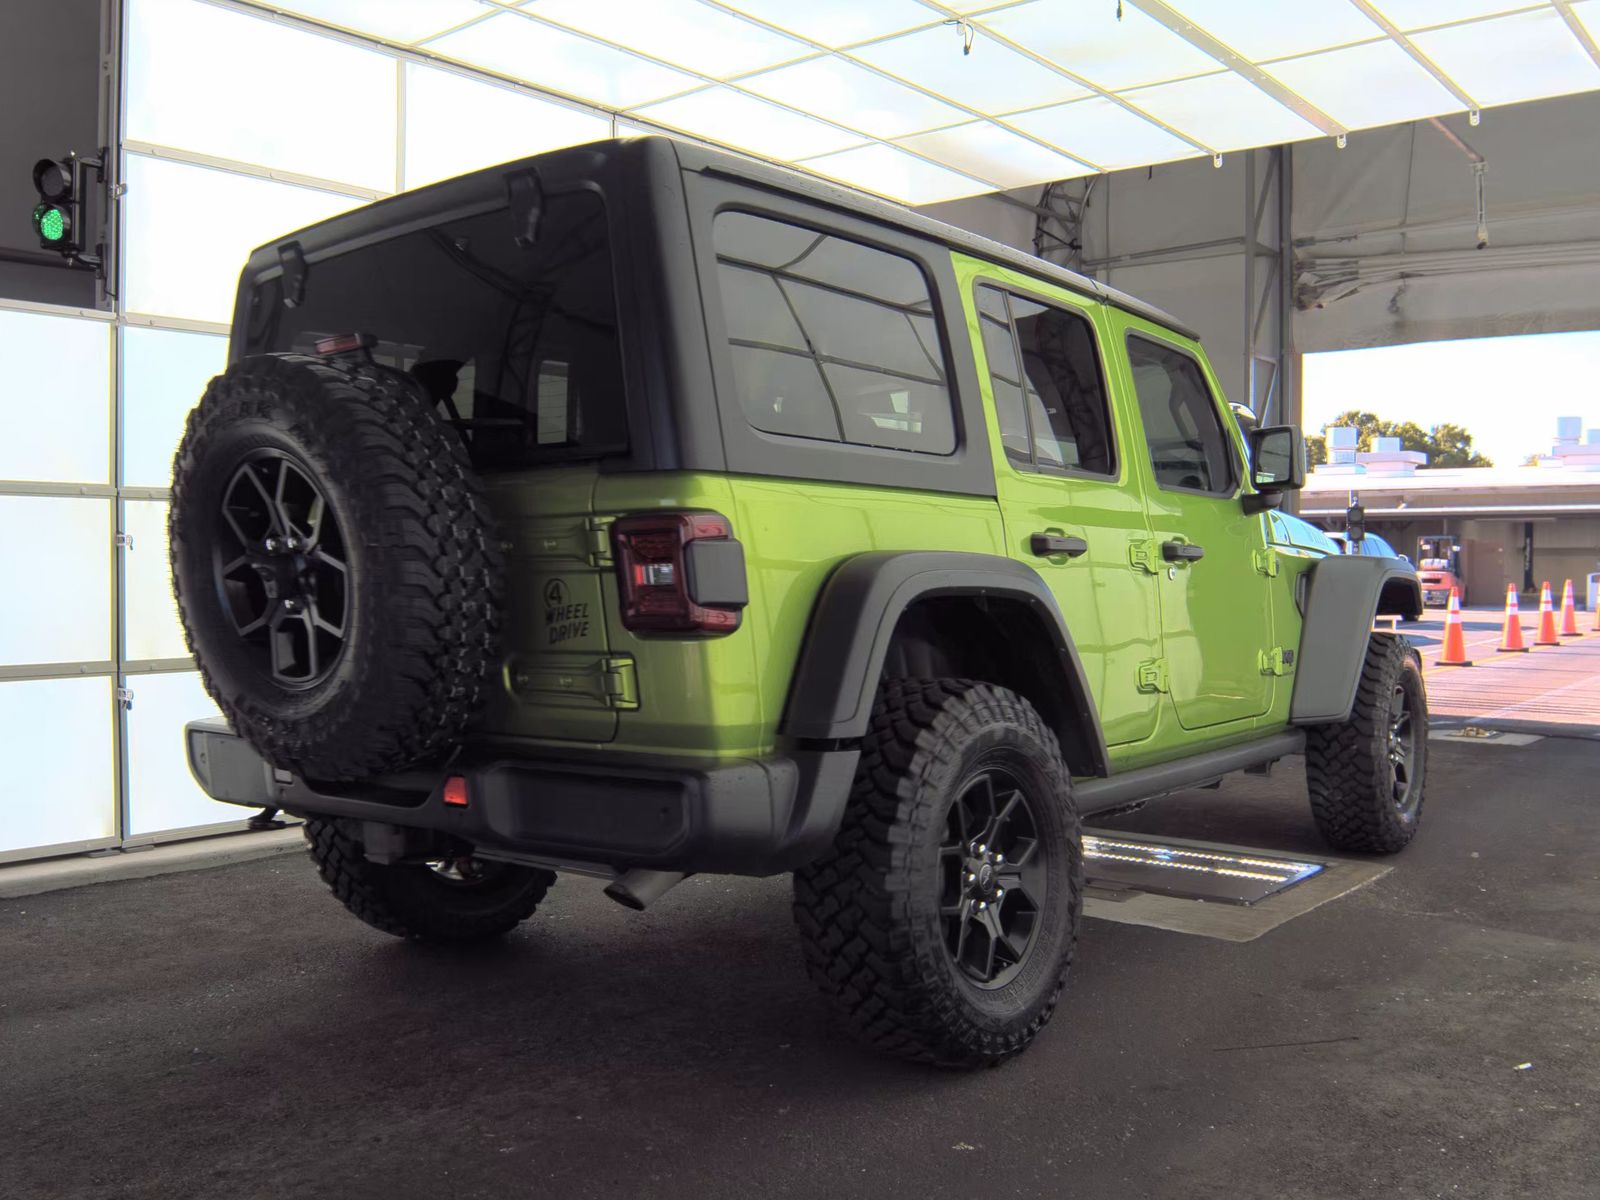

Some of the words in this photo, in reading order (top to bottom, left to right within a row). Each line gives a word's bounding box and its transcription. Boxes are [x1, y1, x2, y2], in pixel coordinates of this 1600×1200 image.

[549, 583, 562, 604] 4
[546, 603, 589, 625] WHEEL
[549, 622, 589, 644] DRIVE
